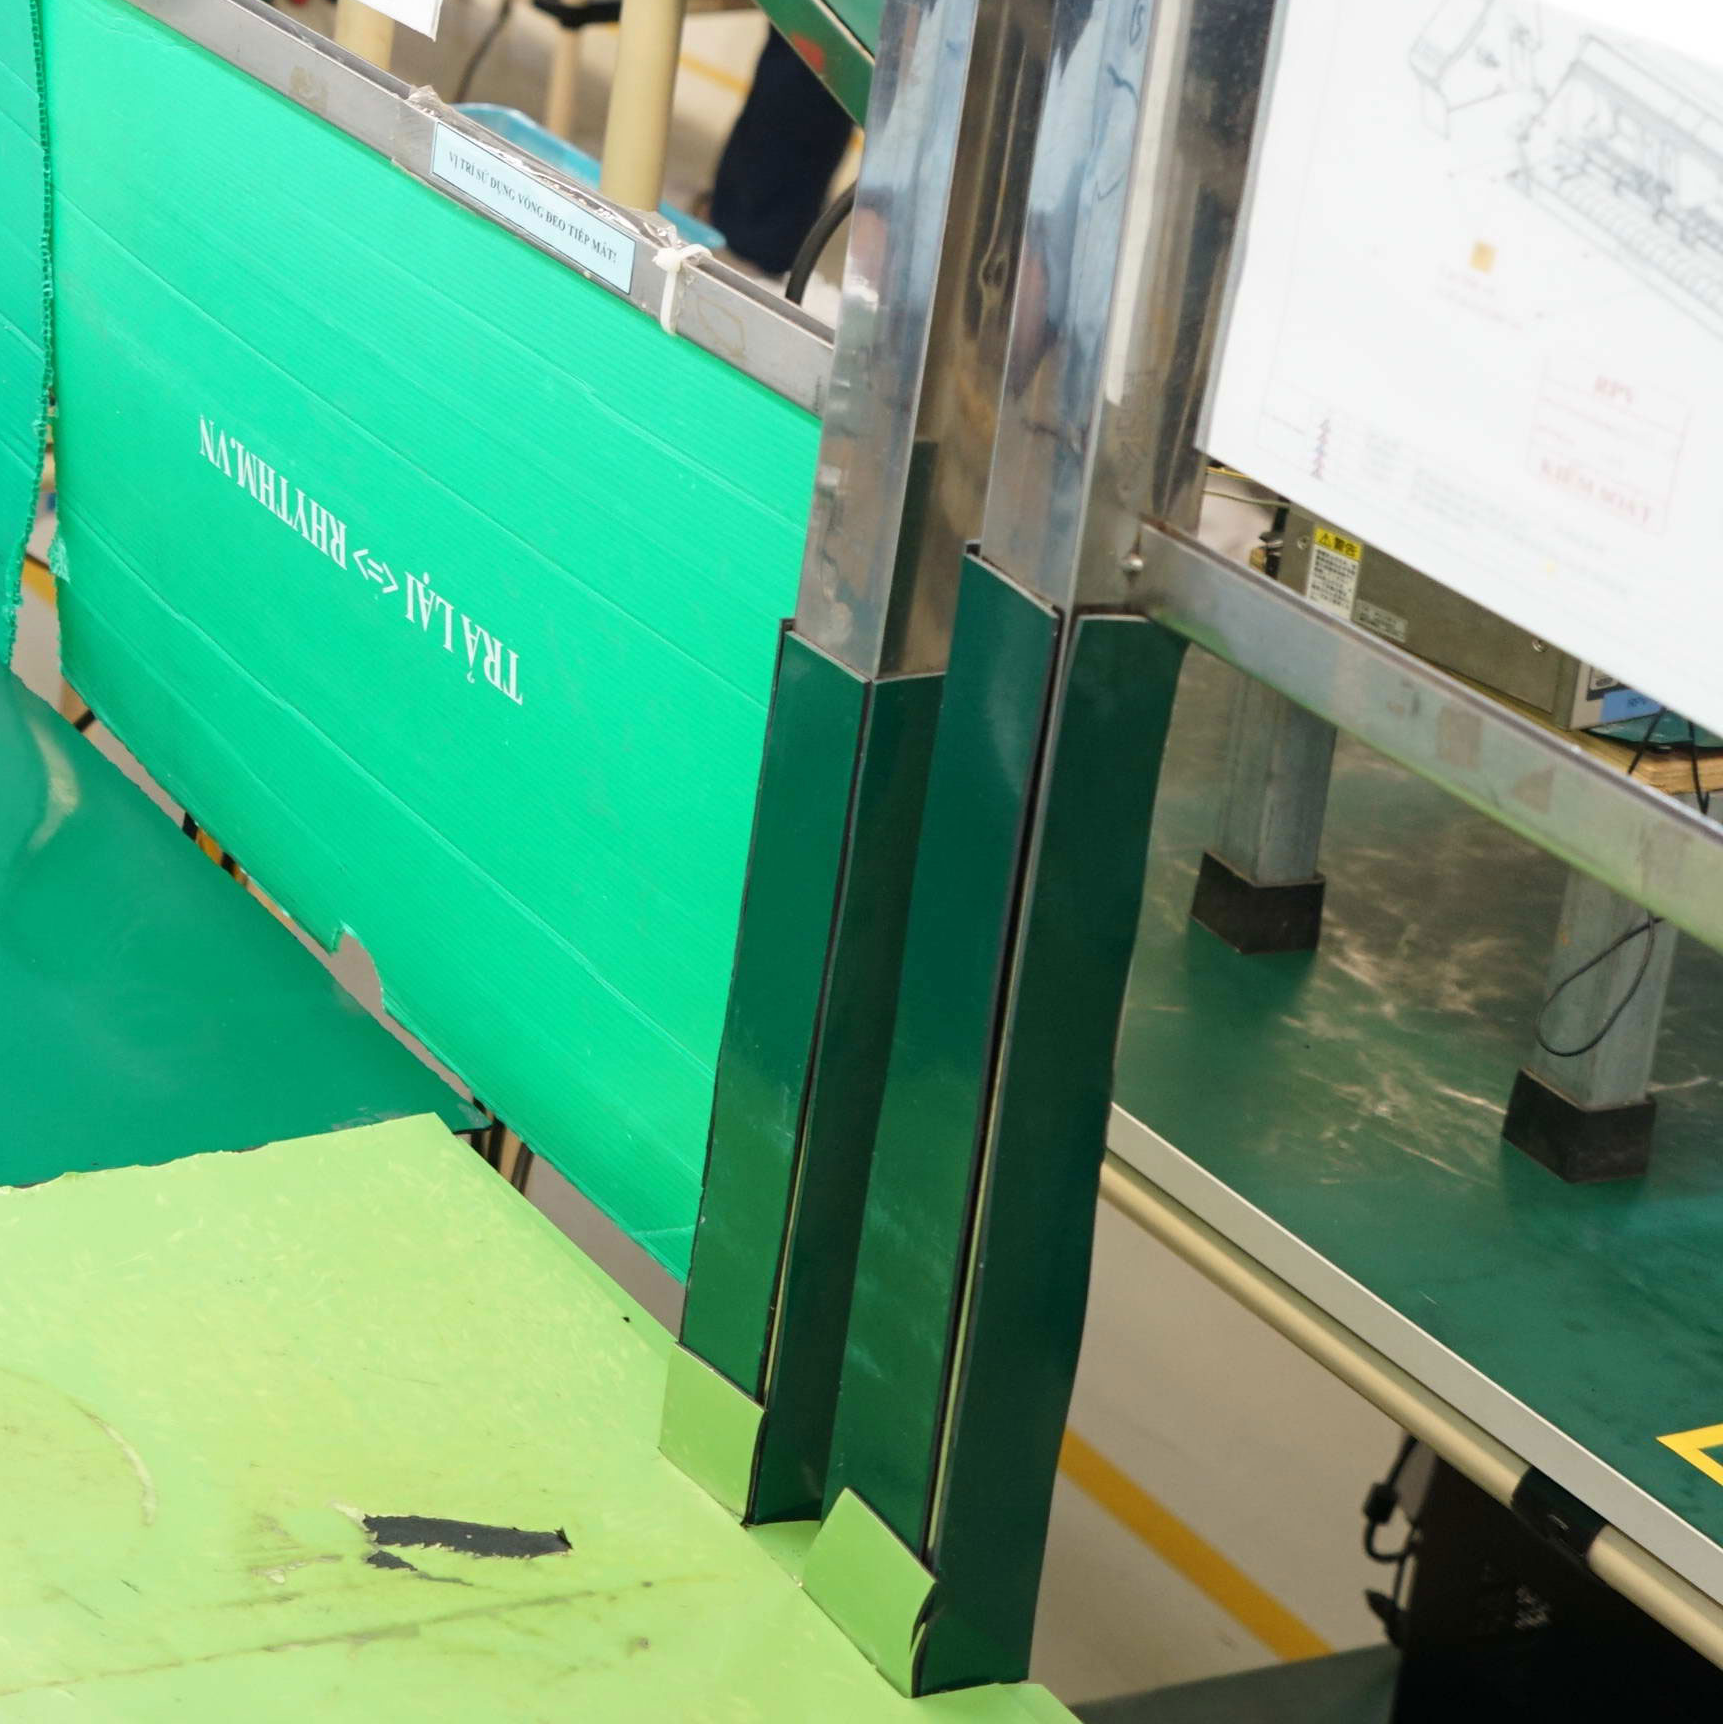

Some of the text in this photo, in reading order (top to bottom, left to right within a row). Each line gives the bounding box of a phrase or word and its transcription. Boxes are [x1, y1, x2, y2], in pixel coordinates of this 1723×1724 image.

[199, 413, 348, 571] RHYTHM.VN
[403, 571, 454, 653] LẠI
[459, 613, 523, 706] TRẢ
